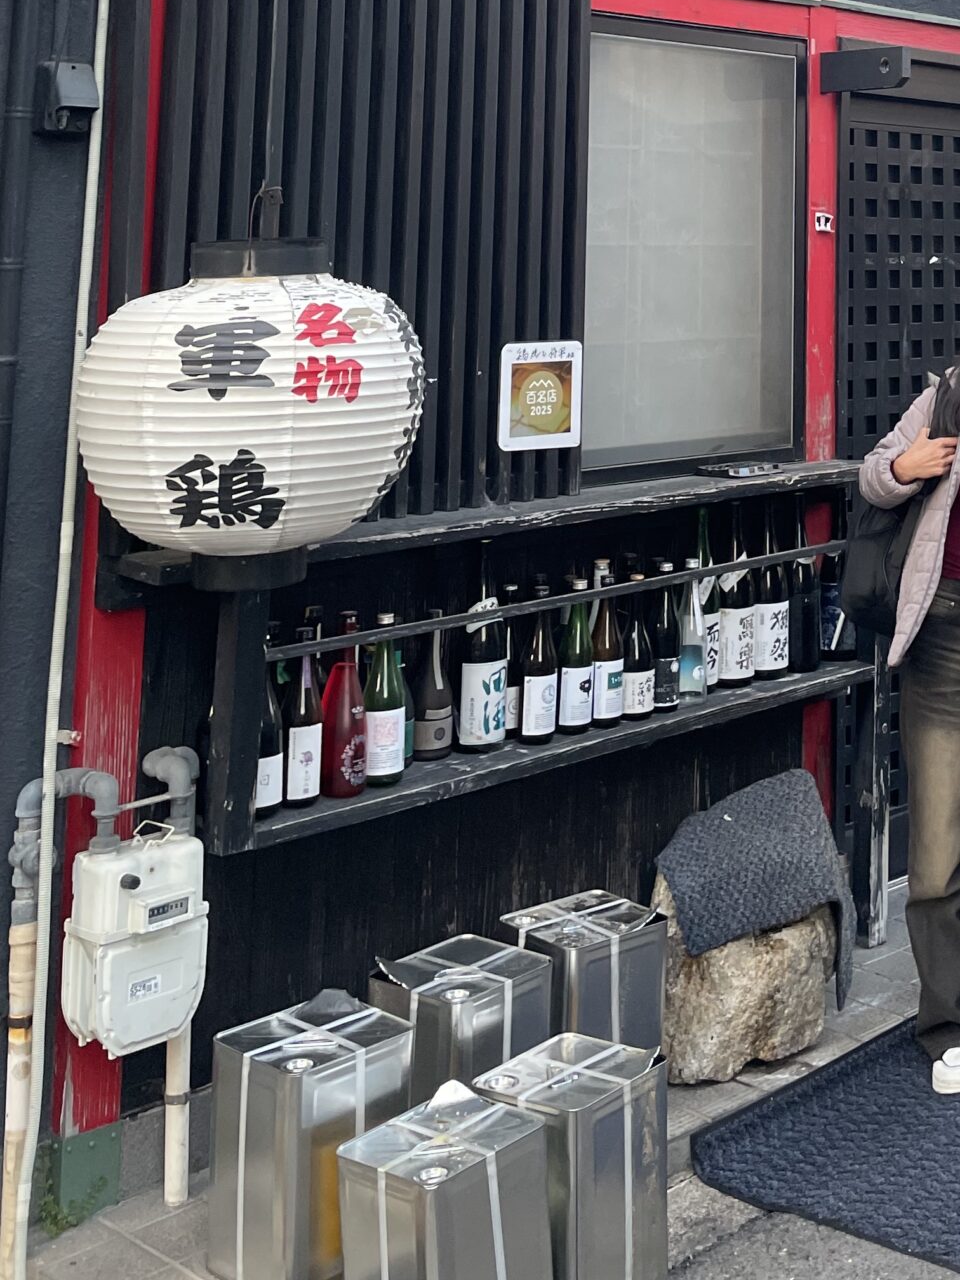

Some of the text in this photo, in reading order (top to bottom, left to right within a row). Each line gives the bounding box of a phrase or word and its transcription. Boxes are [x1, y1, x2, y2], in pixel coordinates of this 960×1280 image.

[291, 302, 364, 404] 名物
[526, 390, 558, 404] 百名店
[530, 405, 552, 416] 2025
[166, 320, 286, 530] 軍鶏
[706, 622, 719, 670] 而今
